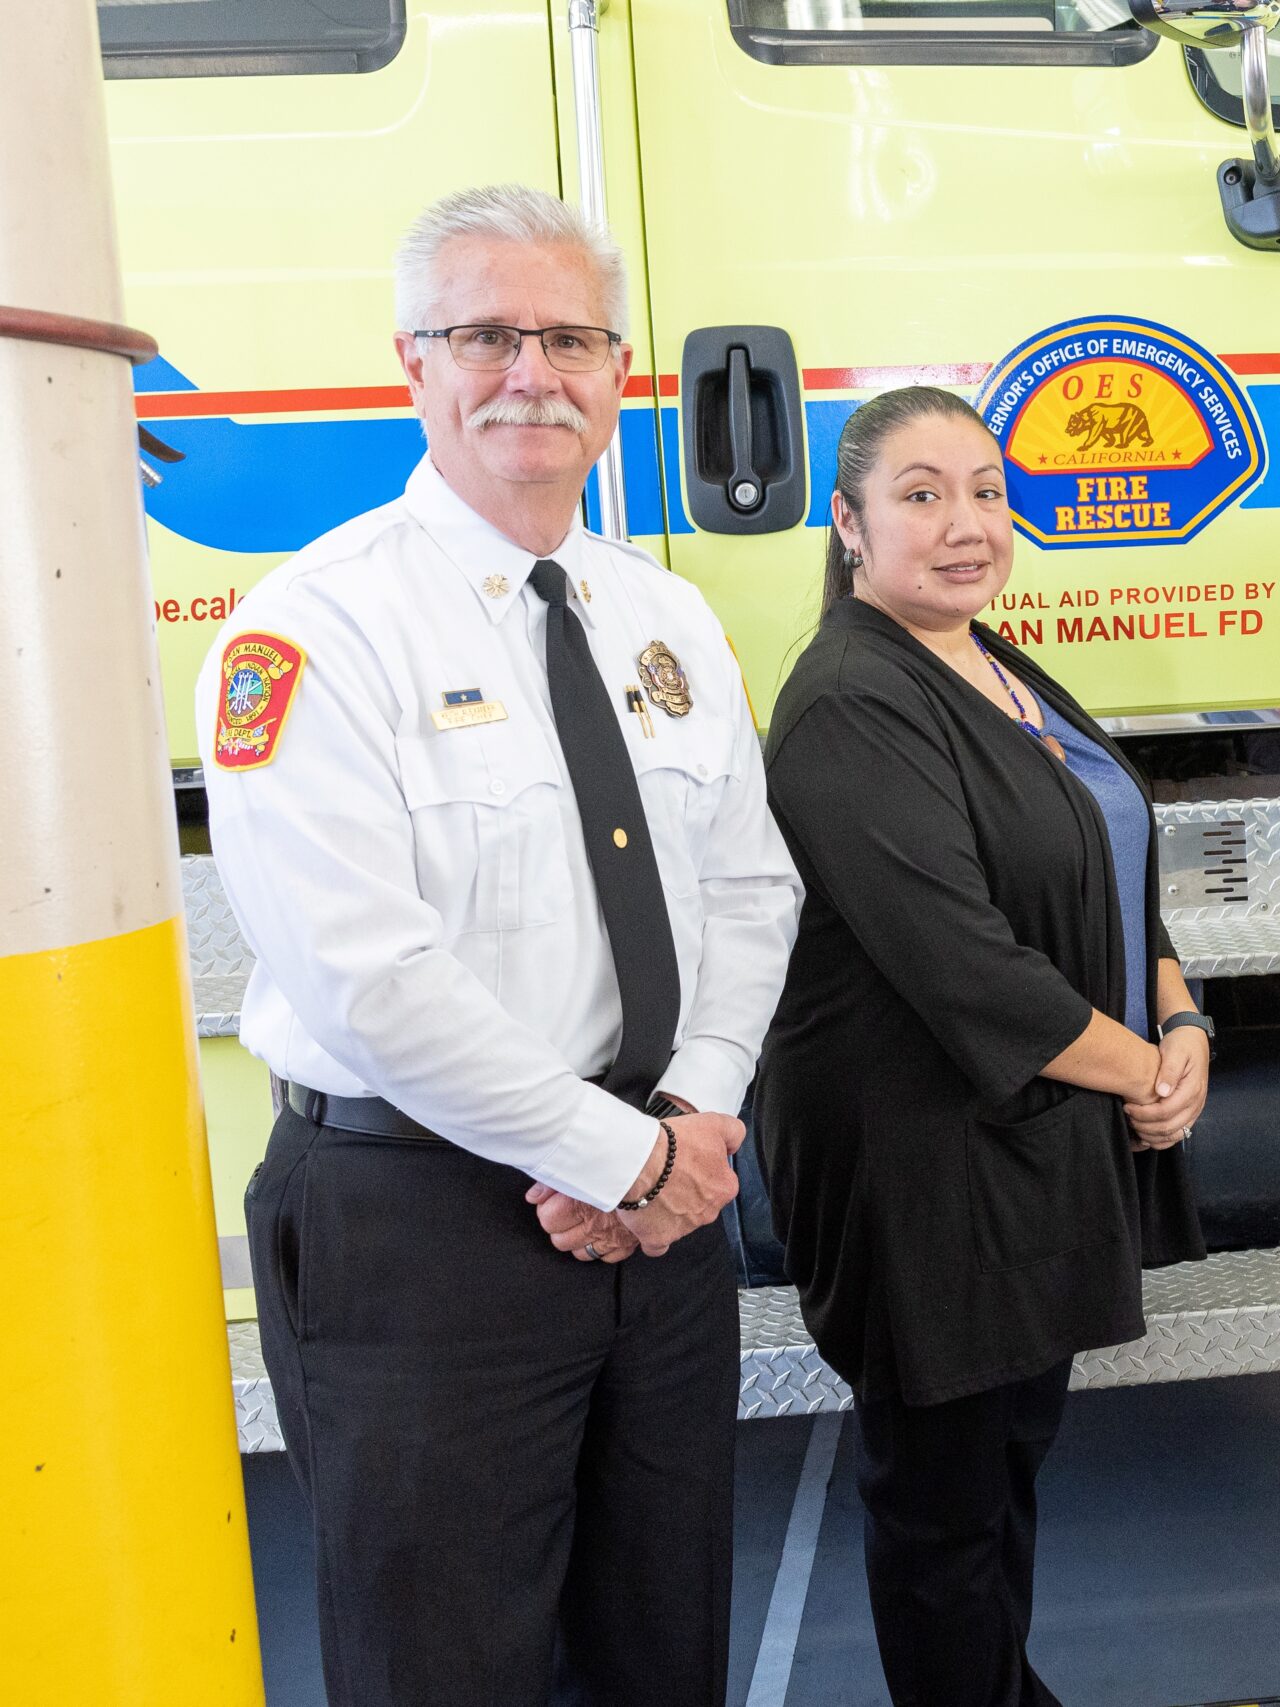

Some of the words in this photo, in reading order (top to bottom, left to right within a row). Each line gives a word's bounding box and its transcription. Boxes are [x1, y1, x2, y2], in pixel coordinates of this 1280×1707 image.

[987, 370, 1035, 436] ERNOR'S
[1032, 342, 1085, 377] OFFICE
[1086, 338, 1109, 355] OF
[1112, 338, 1205, 389] EMERGENCY
[1198, 386, 1242, 460] SERVICES
[1053, 450, 1166, 465] CALIFORNIA
[1076, 475, 1148, 502] FIRE
[1055, 502, 1171, 531] RESCUE
[155, 588, 245, 623] e.cal
[990, 592, 1050, 611] TUAL
[1059, 589, 1100, 608] AID
[1110, 584, 1235, 605] PROVIDED
[1245, 582, 1276, 600] BY
[981, 618, 1043, 646] AN
[1057, 611, 1207, 644] MANUEL
[1219, 609, 1263, 636] FD
[243, 643, 279, 662] MANUEL
